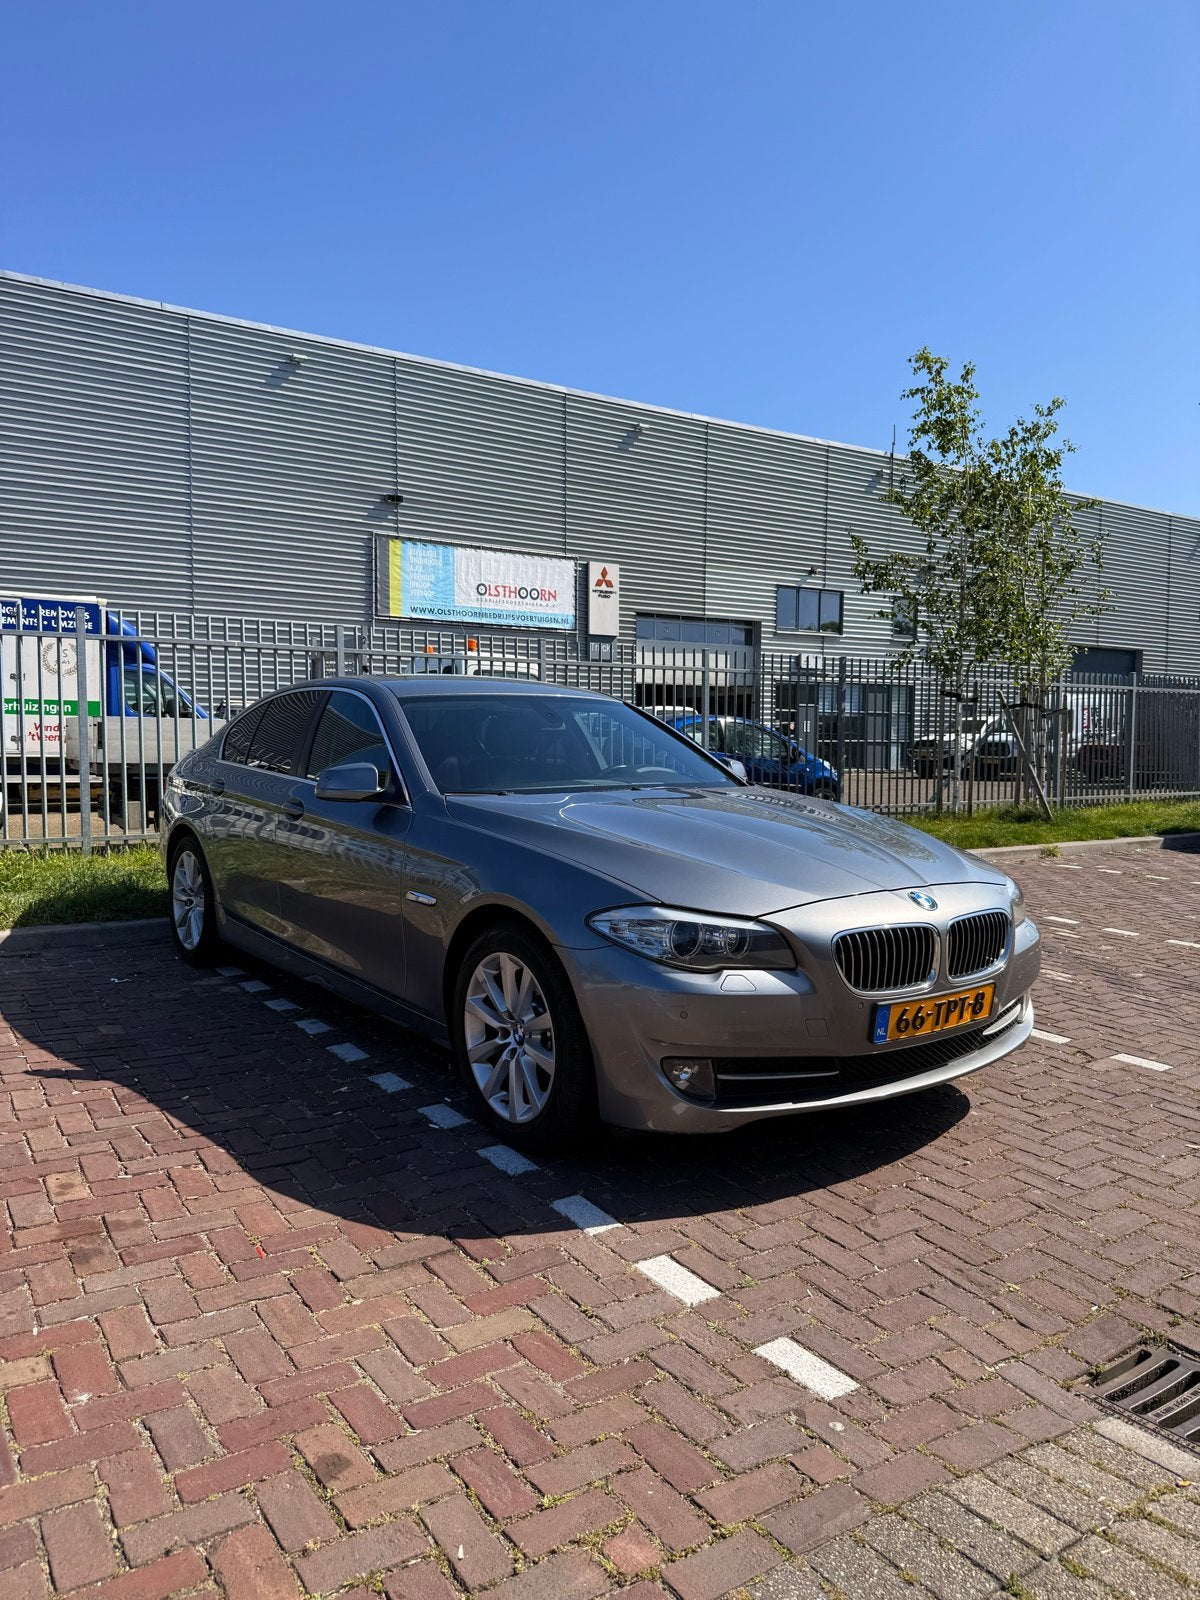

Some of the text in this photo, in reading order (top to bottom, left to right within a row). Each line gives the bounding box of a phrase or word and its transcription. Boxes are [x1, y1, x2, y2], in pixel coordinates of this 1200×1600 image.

[476, 583, 557, 602] OLSTHOORN
[40, 608, 90, 620] REMOVS
[410, 606, 570, 625] WWW.OLSTHOORNBEDRIJFSVOERTUIGEN.NL
[896, 990, 986, 1034] 66-TPT-8
[876, 1027, 886, 1036] NL
